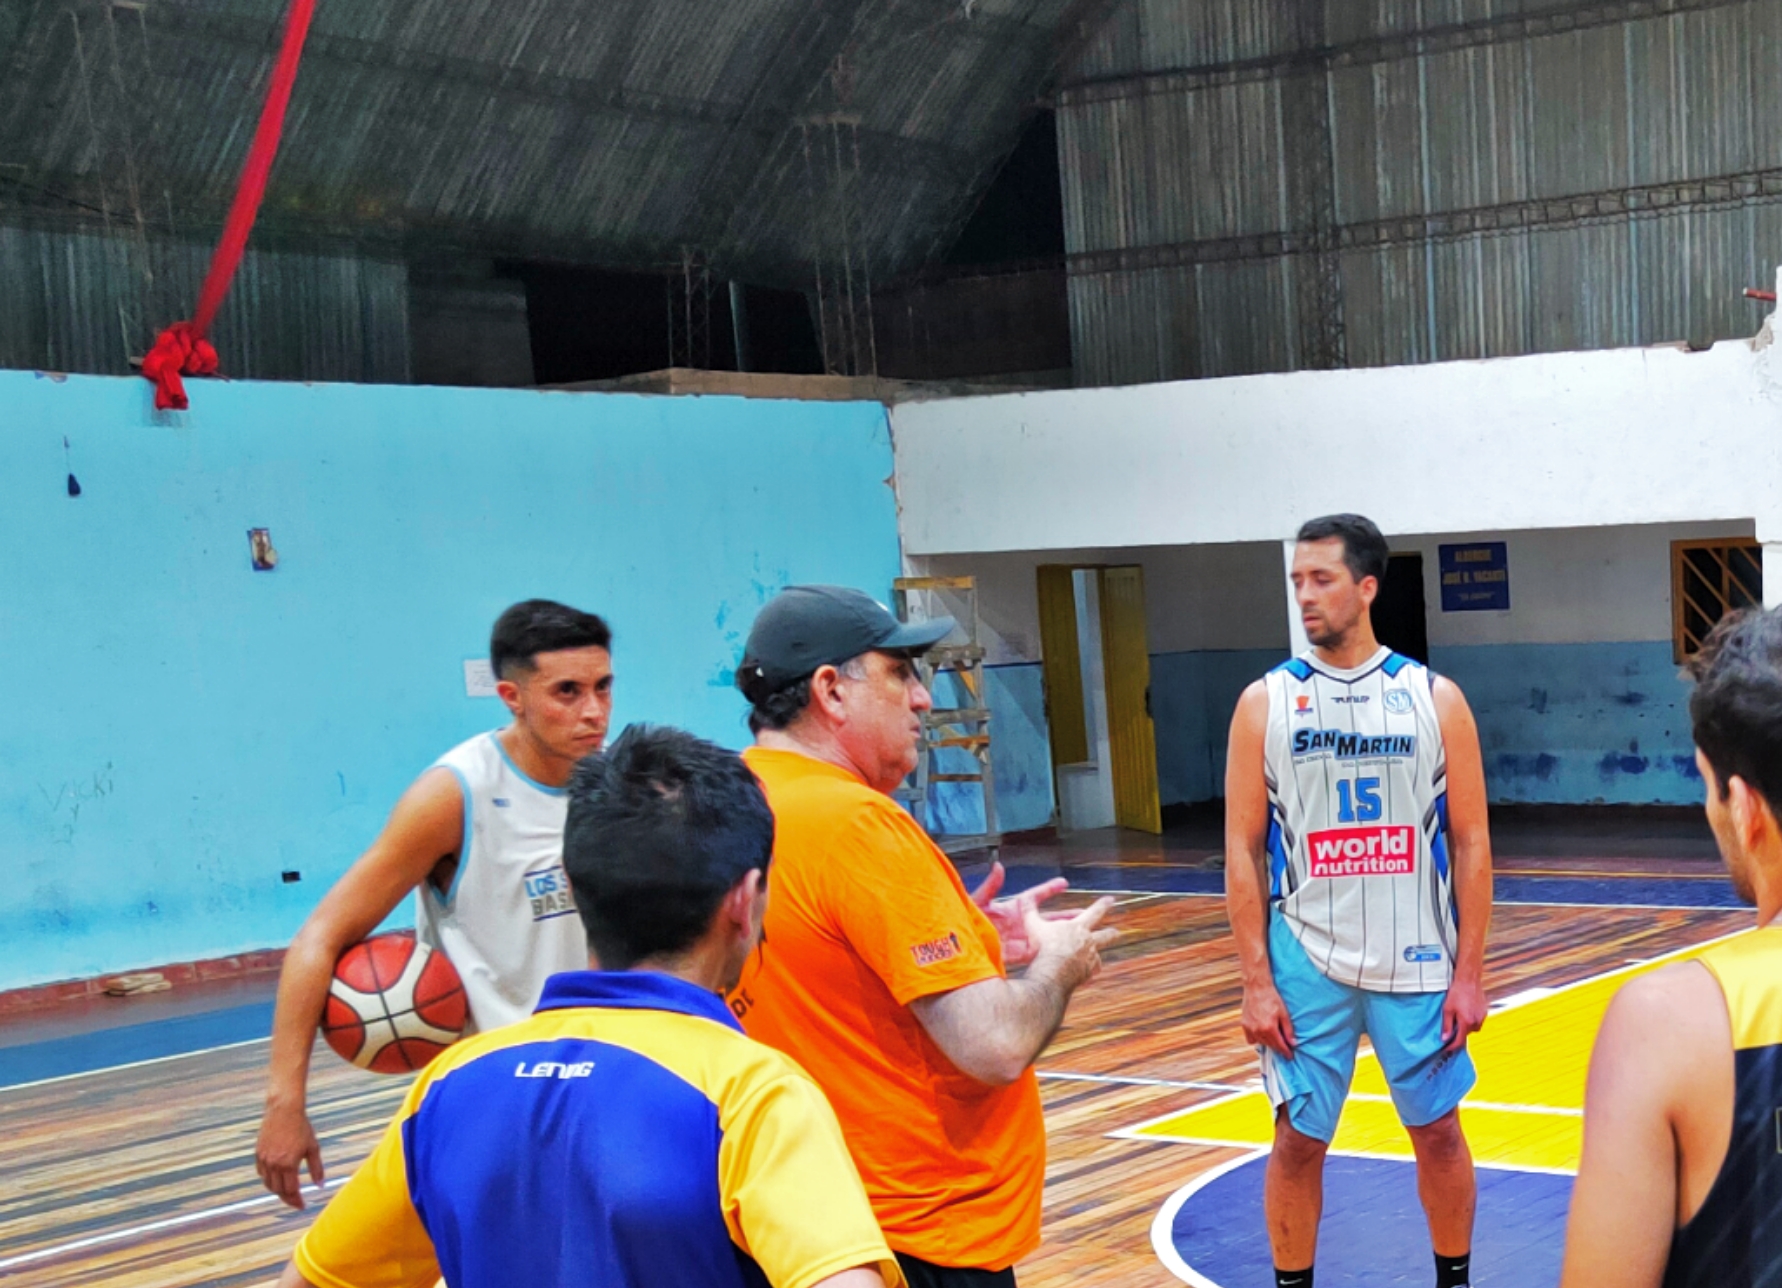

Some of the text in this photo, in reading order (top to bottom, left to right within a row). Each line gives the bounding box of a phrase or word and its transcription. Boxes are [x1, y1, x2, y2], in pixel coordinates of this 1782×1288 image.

[1336, 777, 1382, 823] 15
[1314, 828, 1408, 860] world
[1314, 857, 1409, 876] nutrition
